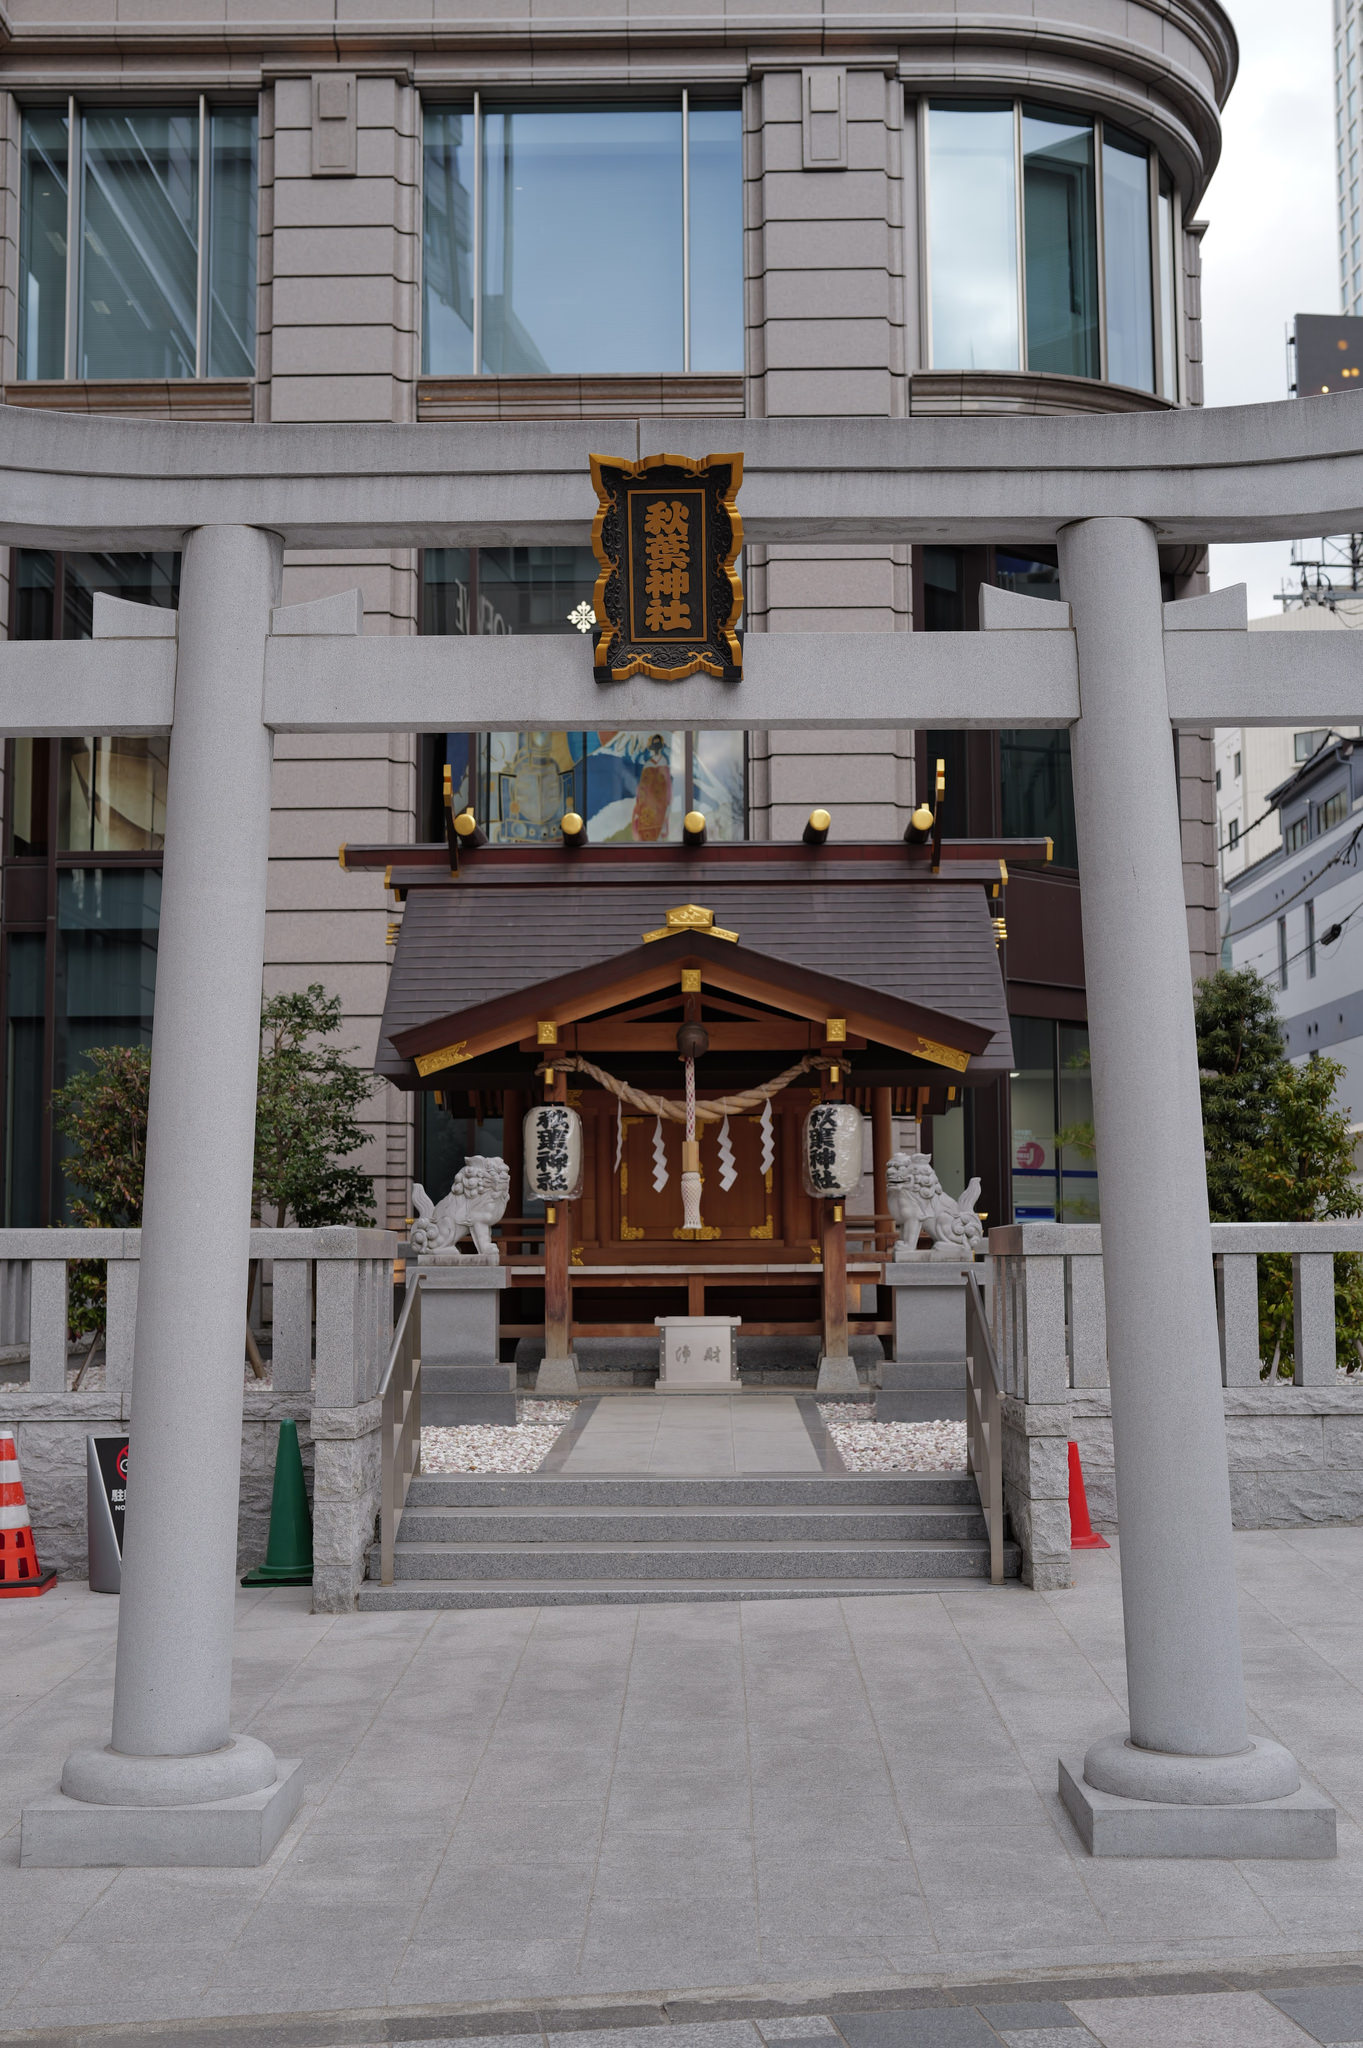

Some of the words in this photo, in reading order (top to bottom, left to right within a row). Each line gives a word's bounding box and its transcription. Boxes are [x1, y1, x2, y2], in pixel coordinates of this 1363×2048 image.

[644, 501, 692, 632] 秋葉神社
[808, 1107, 841, 1190] 秋葉神社
[111, 1488, 127, 1502] 駐
